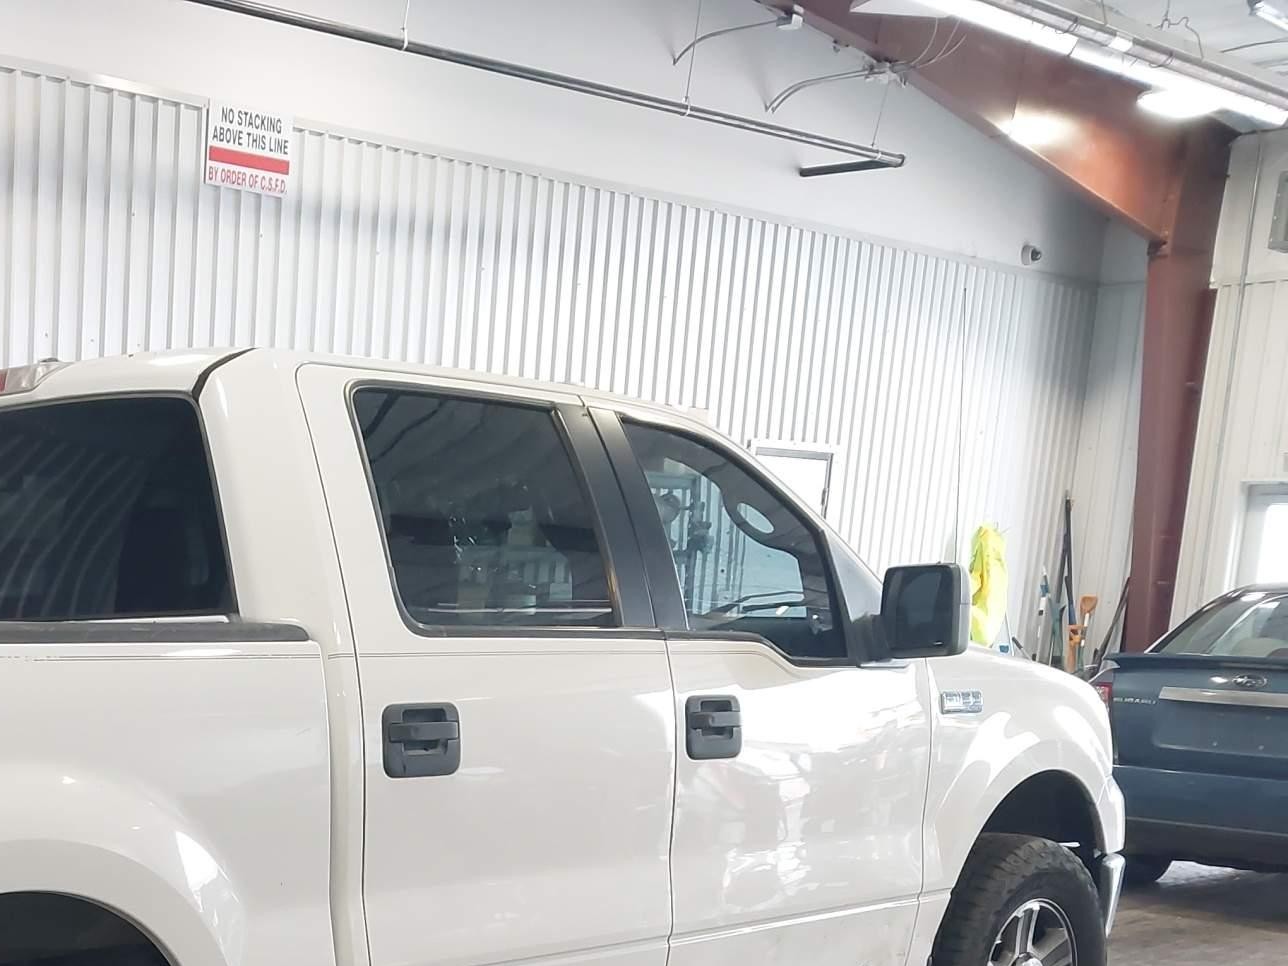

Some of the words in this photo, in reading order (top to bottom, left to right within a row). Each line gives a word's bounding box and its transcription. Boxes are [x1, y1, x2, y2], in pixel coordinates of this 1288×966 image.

[221, 106, 235, 124] NO
[237, 110, 282, 134] STACKING
[212, 125, 243, 146] ABOVE
[246, 132, 266, 151] THIS
[269, 137, 289, 155] LINE
[208, 166, 218, 181] BY
[220, 168, 247, 187] ORDER
[248, 174, 259, 188] OF
